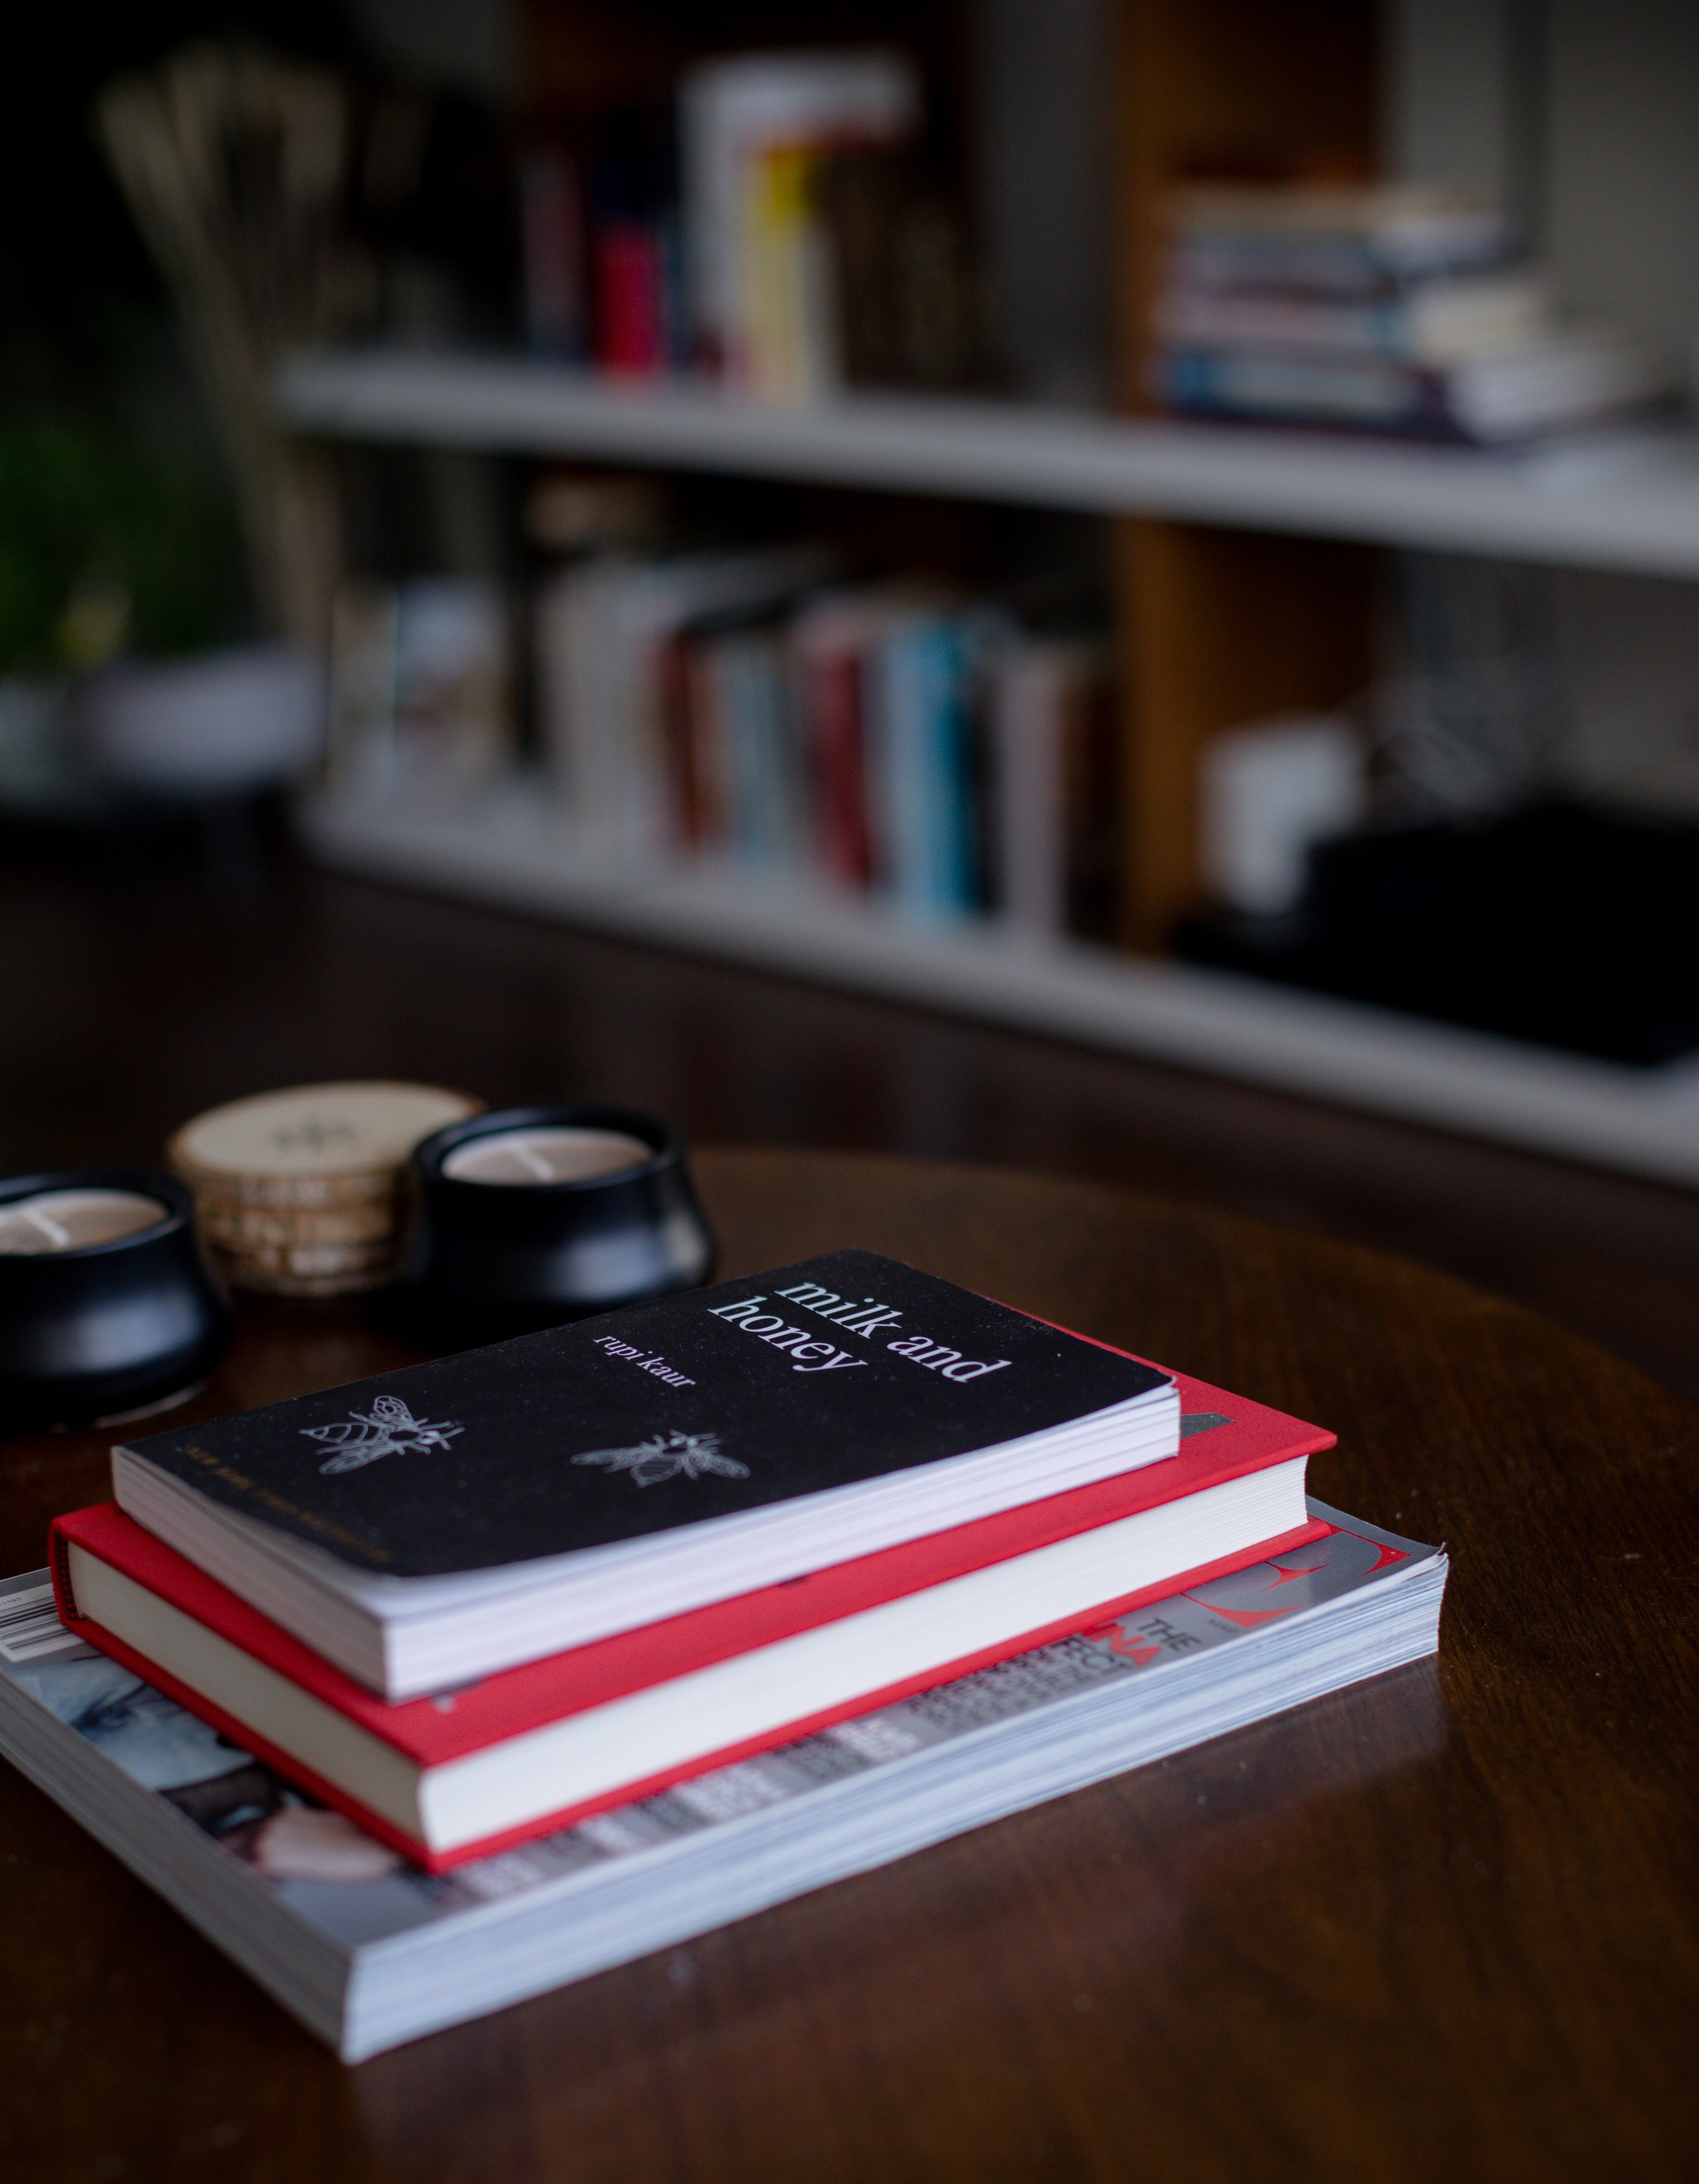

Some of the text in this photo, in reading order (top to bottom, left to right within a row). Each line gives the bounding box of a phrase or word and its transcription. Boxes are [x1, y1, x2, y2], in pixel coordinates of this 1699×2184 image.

[593, 1336, 696, 1387] rupi kaur
[707, 1296, 868, 1371] honey
[774, 1282, 1012, 1383] milk and
[1137, 1617, 1202, 1651] THE
